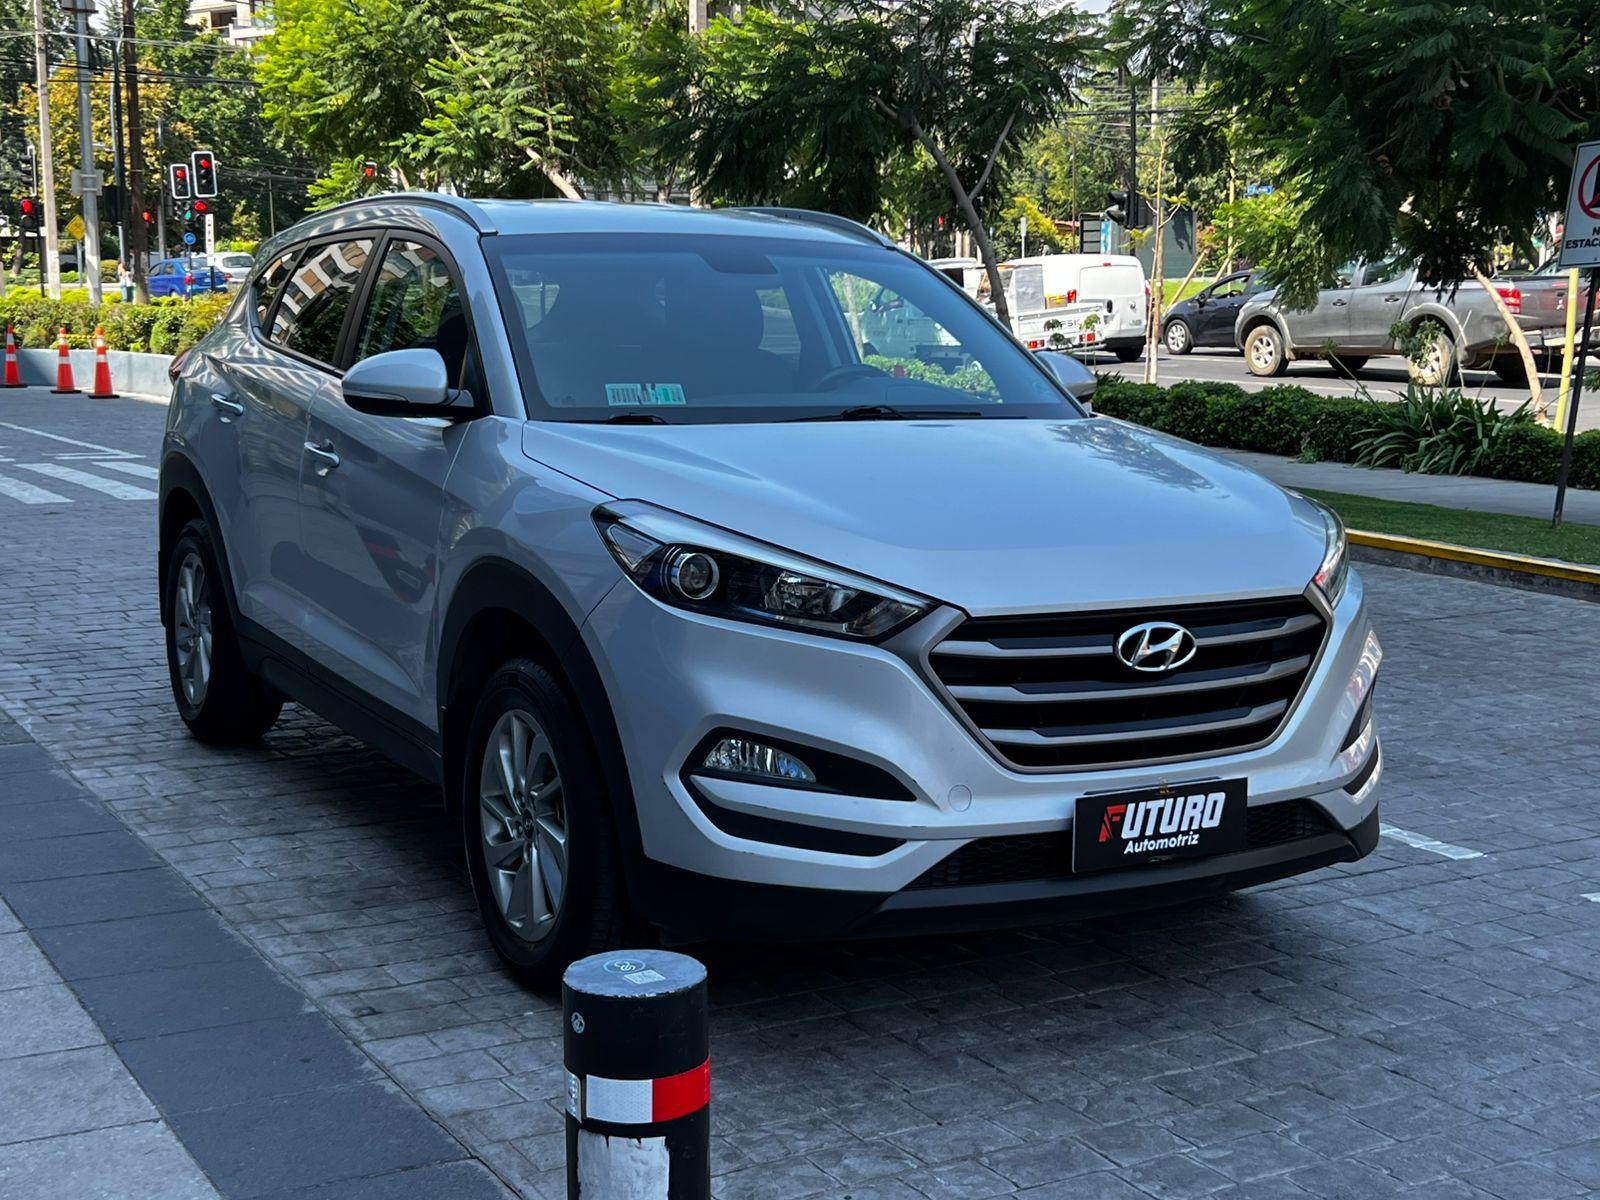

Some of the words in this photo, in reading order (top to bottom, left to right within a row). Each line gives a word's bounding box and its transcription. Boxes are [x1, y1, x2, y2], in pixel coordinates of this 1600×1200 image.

[1565, 238, 1600, 249] ESTAC
[1099, 792, 1226, 842] FUTURO
[1124, 831, 1200, 854] Automotriz
